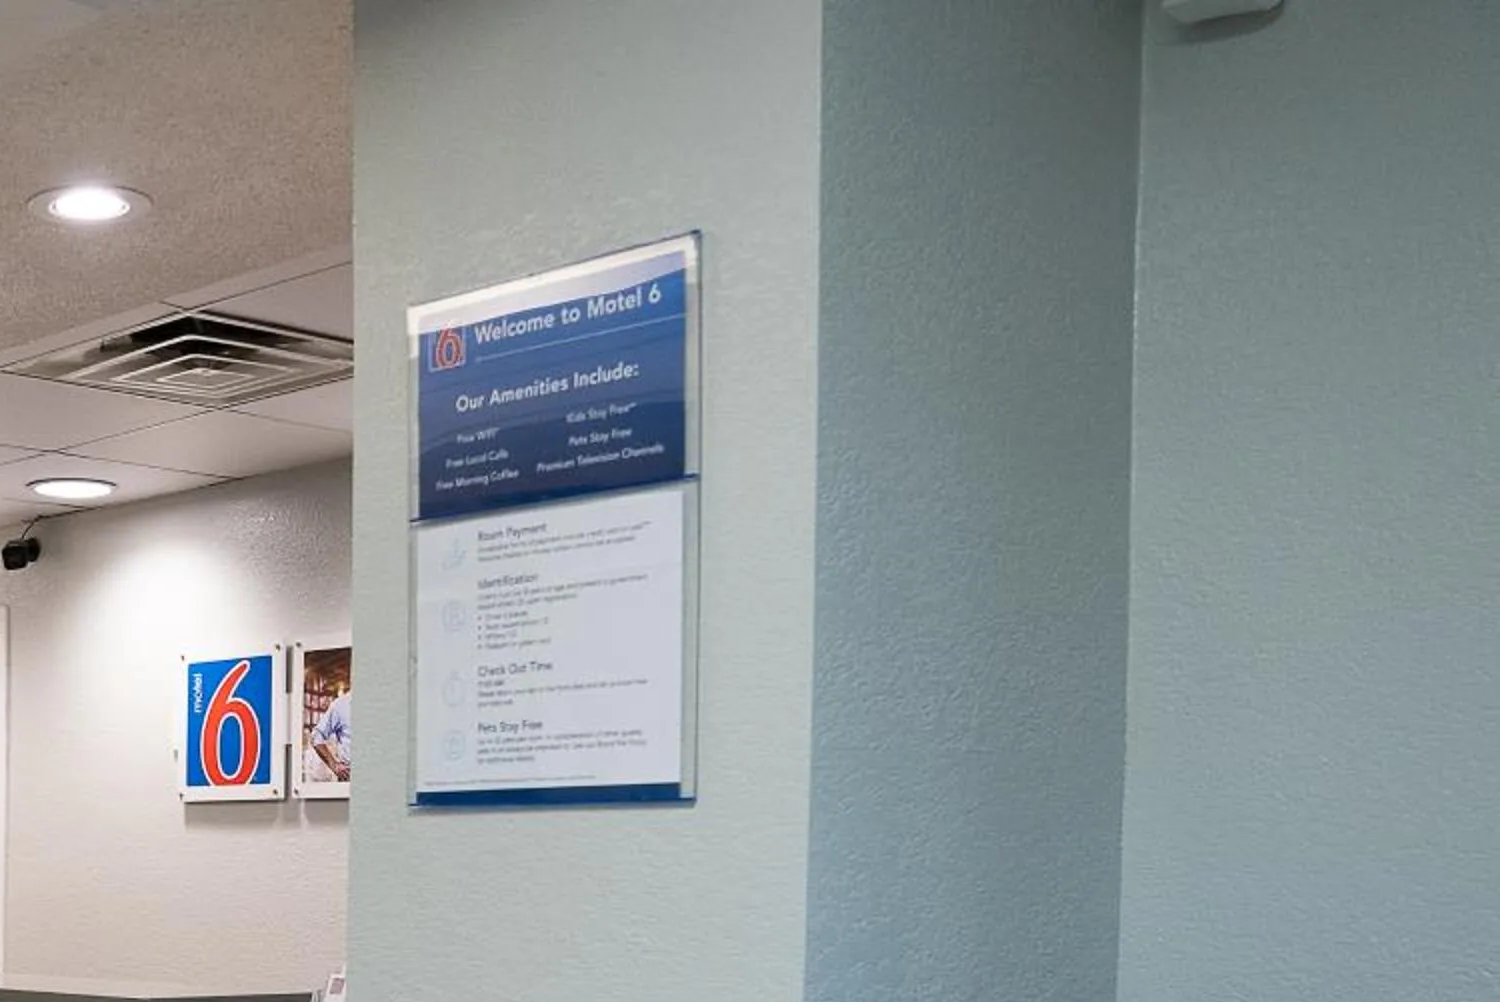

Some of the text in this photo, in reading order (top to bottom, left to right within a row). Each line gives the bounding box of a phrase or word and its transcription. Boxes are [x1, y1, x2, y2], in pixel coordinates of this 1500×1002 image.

[474, 283, 662, 345] Welcome to Motel 6
[456, 362, 639, 413] Our Amenities Include:
[587, 407, 607, 420] Stay
[568, 428, 632, 447] Pets Stay Free
[445, 448, 509, 469] Free Local Calls
[536, 444, 664, 474] Premium Television Channels
[435, 468, 519, 492] Free Morning Coffee
[505, 523, 547, 540] Payment
[477, 573, 540, 590] Identification
[477, 660, 553, 677] Check Out Time
[193, 673, 203, 713] motel
[201, 660, 261, 787] 6
[477, 718, 543, 735] Pets Stay Free
